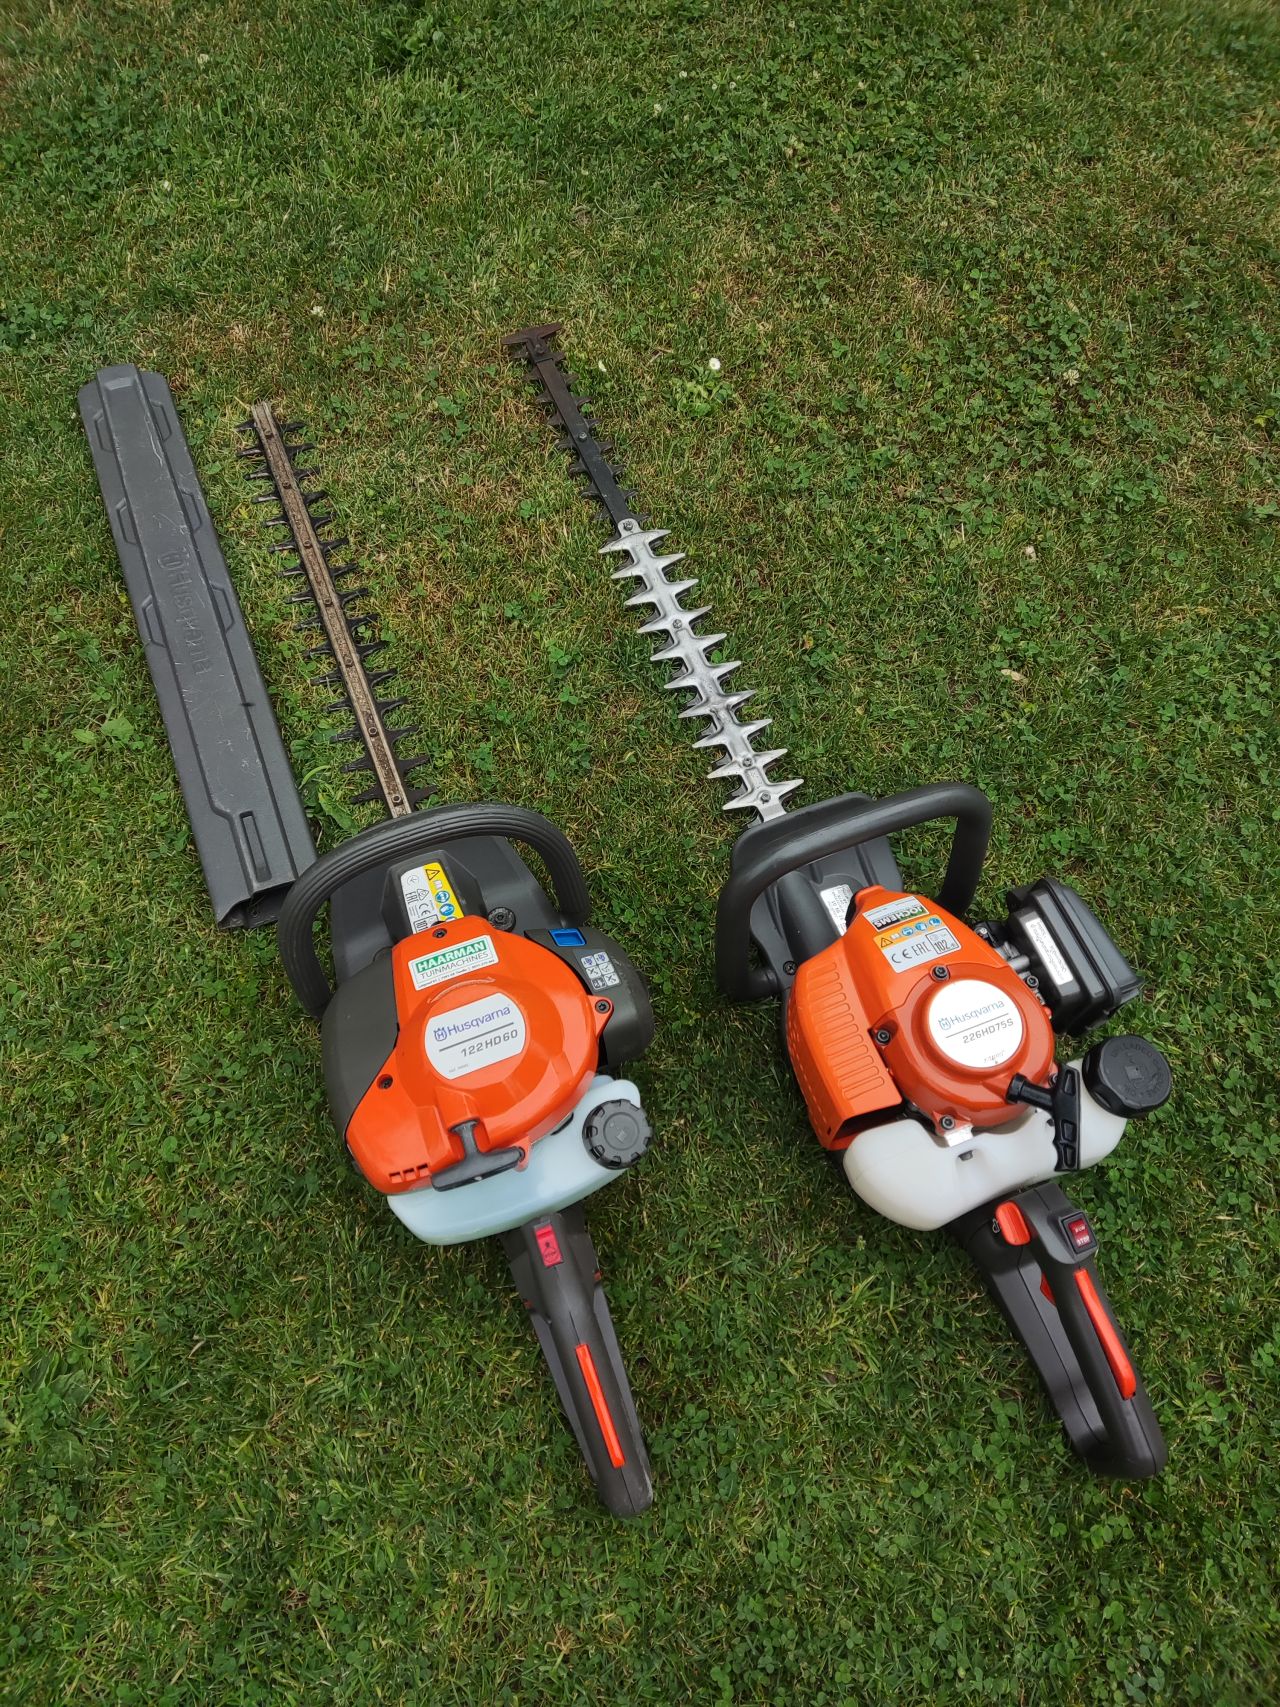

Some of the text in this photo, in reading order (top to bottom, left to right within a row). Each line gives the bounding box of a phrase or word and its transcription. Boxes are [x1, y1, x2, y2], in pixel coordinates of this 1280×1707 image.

[873, 905, 923, 928] JOCHEMS
[417, 940, 485, 972] HAARMAN
[934, 939, 950, 953] 102
[421, 951, 489, 979] TUINMACHINES
[447, 1006, 511, 1036] Husqvarna
[950, 1000, 1005, 1025] Husqvarna
[461, 1029, 518, 1057] 122HD60
[962, 1018, 1014, 1044] 226HD75S
